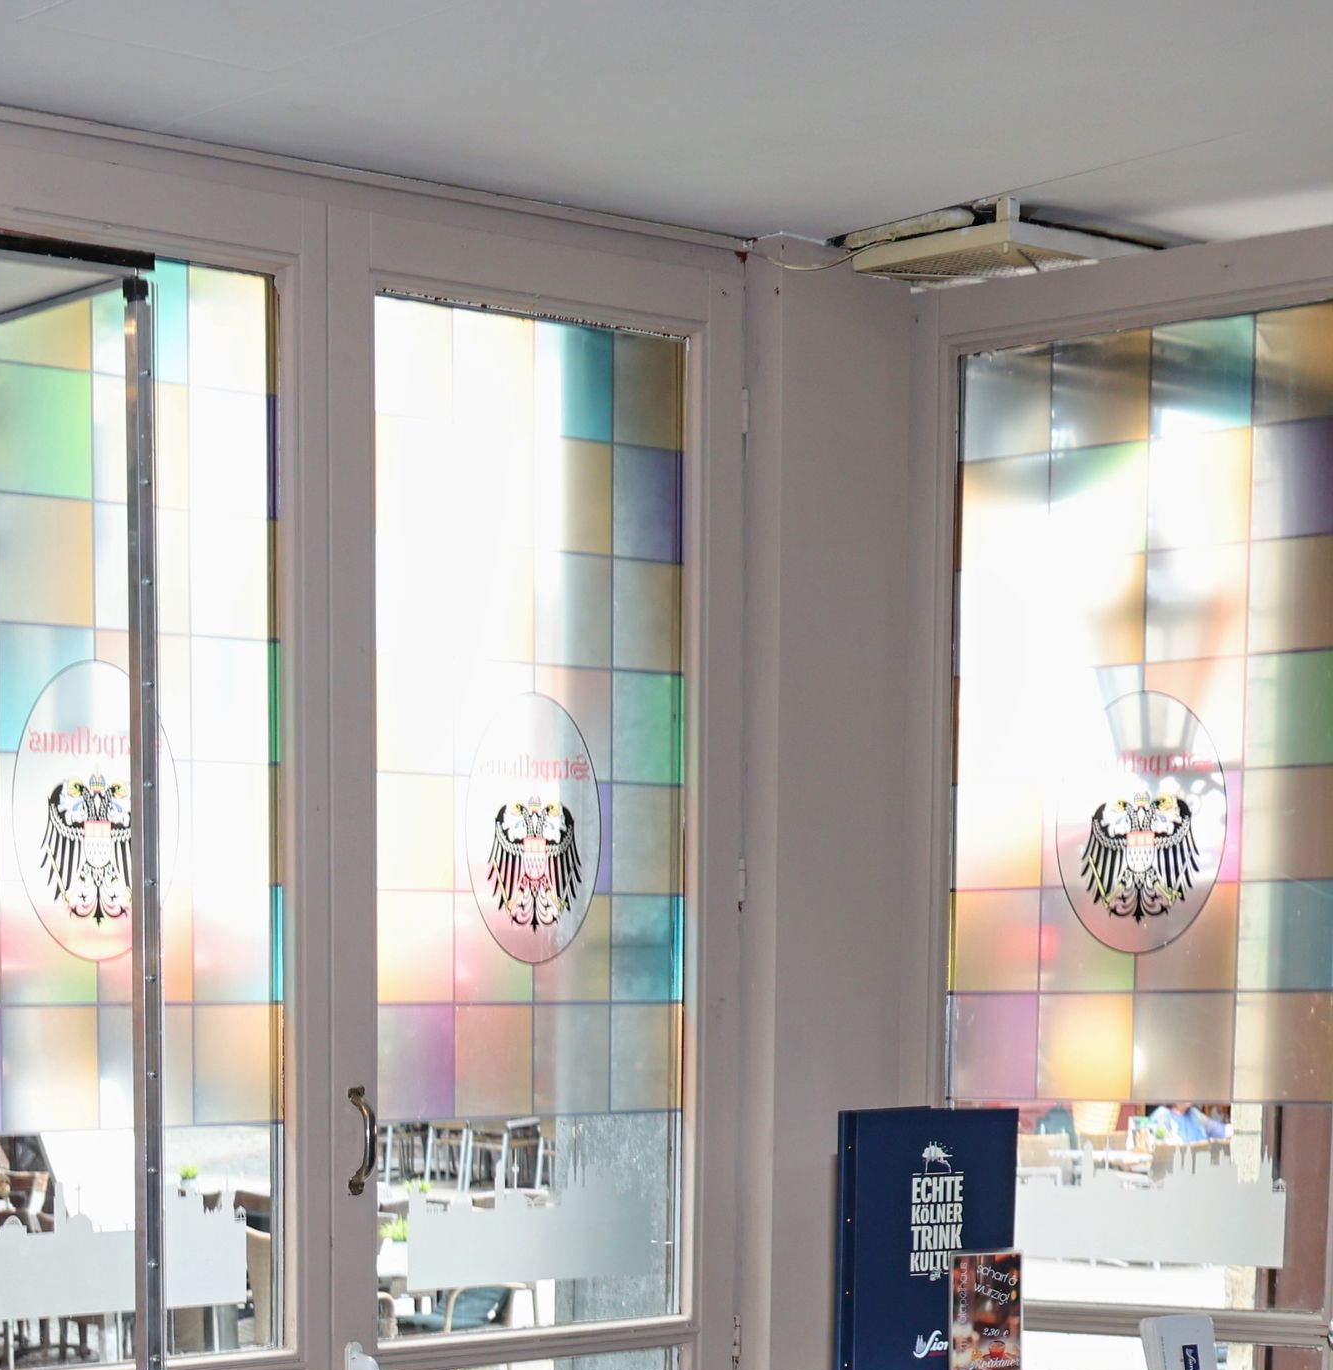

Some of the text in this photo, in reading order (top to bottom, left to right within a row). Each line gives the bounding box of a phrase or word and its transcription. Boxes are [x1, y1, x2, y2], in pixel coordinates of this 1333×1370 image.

[912, 1175, 964, 1204] ECHTE
[911, 1203, 963, 1225] KÖLNER
[910, 1224, 963, 1251] TRINK
[910, 1251, 950, 1272] KULTU
